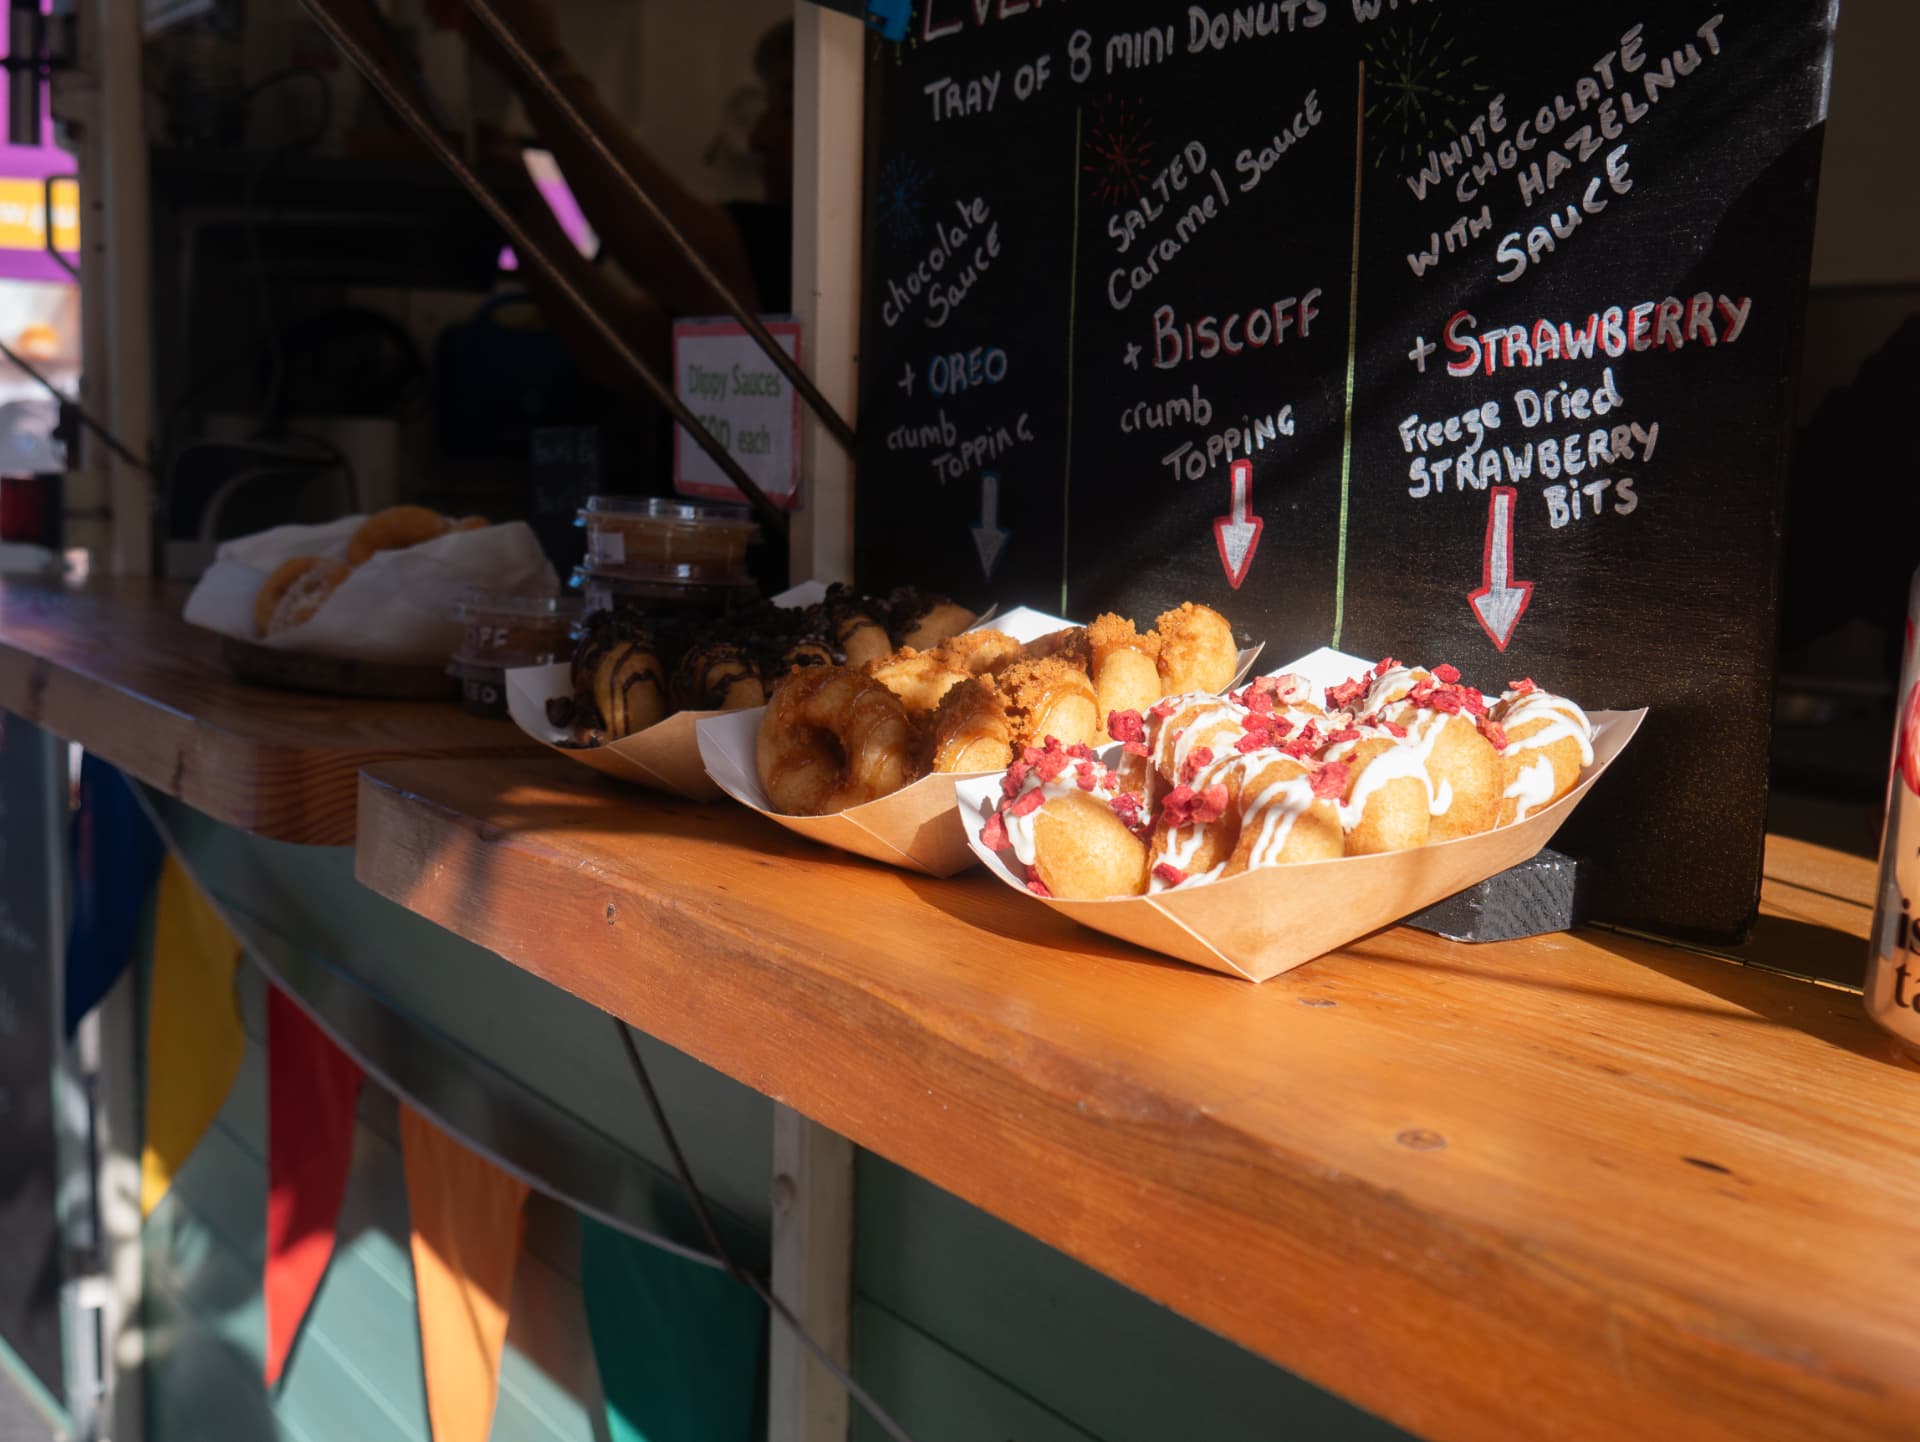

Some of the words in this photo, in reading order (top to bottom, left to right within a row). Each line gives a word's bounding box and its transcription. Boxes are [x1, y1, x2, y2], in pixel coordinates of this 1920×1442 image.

[924, 71, 1001, 121] TRAY
[1014, 55, 1051, 101] OF
[1067, 29, 1092, 83] 8
[1187, 0, 1328, 54] DONUTS
[1406, 93, 1507, 201] WHITE
[1455, 23, 1647, 203] CHOCOLATE
[1516, 13, 1725, 208] HAZELNUT
[1107, 140, 1208, 254] SALTED
[1107, 168, 1230, 310] Caramel
[1406, 204, 1494, 277] WITH
[1495, 143, 1635, 283] SAUCE
[927, 346, 1009, 396] OREO
[1152, 287, 1323, 369] BISCOFF
[1443, 292, 1753, 378] STRAWBERRY
[732, 362, 782, 398] Sauces
[1119, 384, 1214, 434] crumb
[1397, 400, 1502, 460] Freeze
[1513, 366, 1624, 429] Dried
[886, 408, 957, 451] crumb
[1407, 421, 1661, 499] STRAWBERRY
